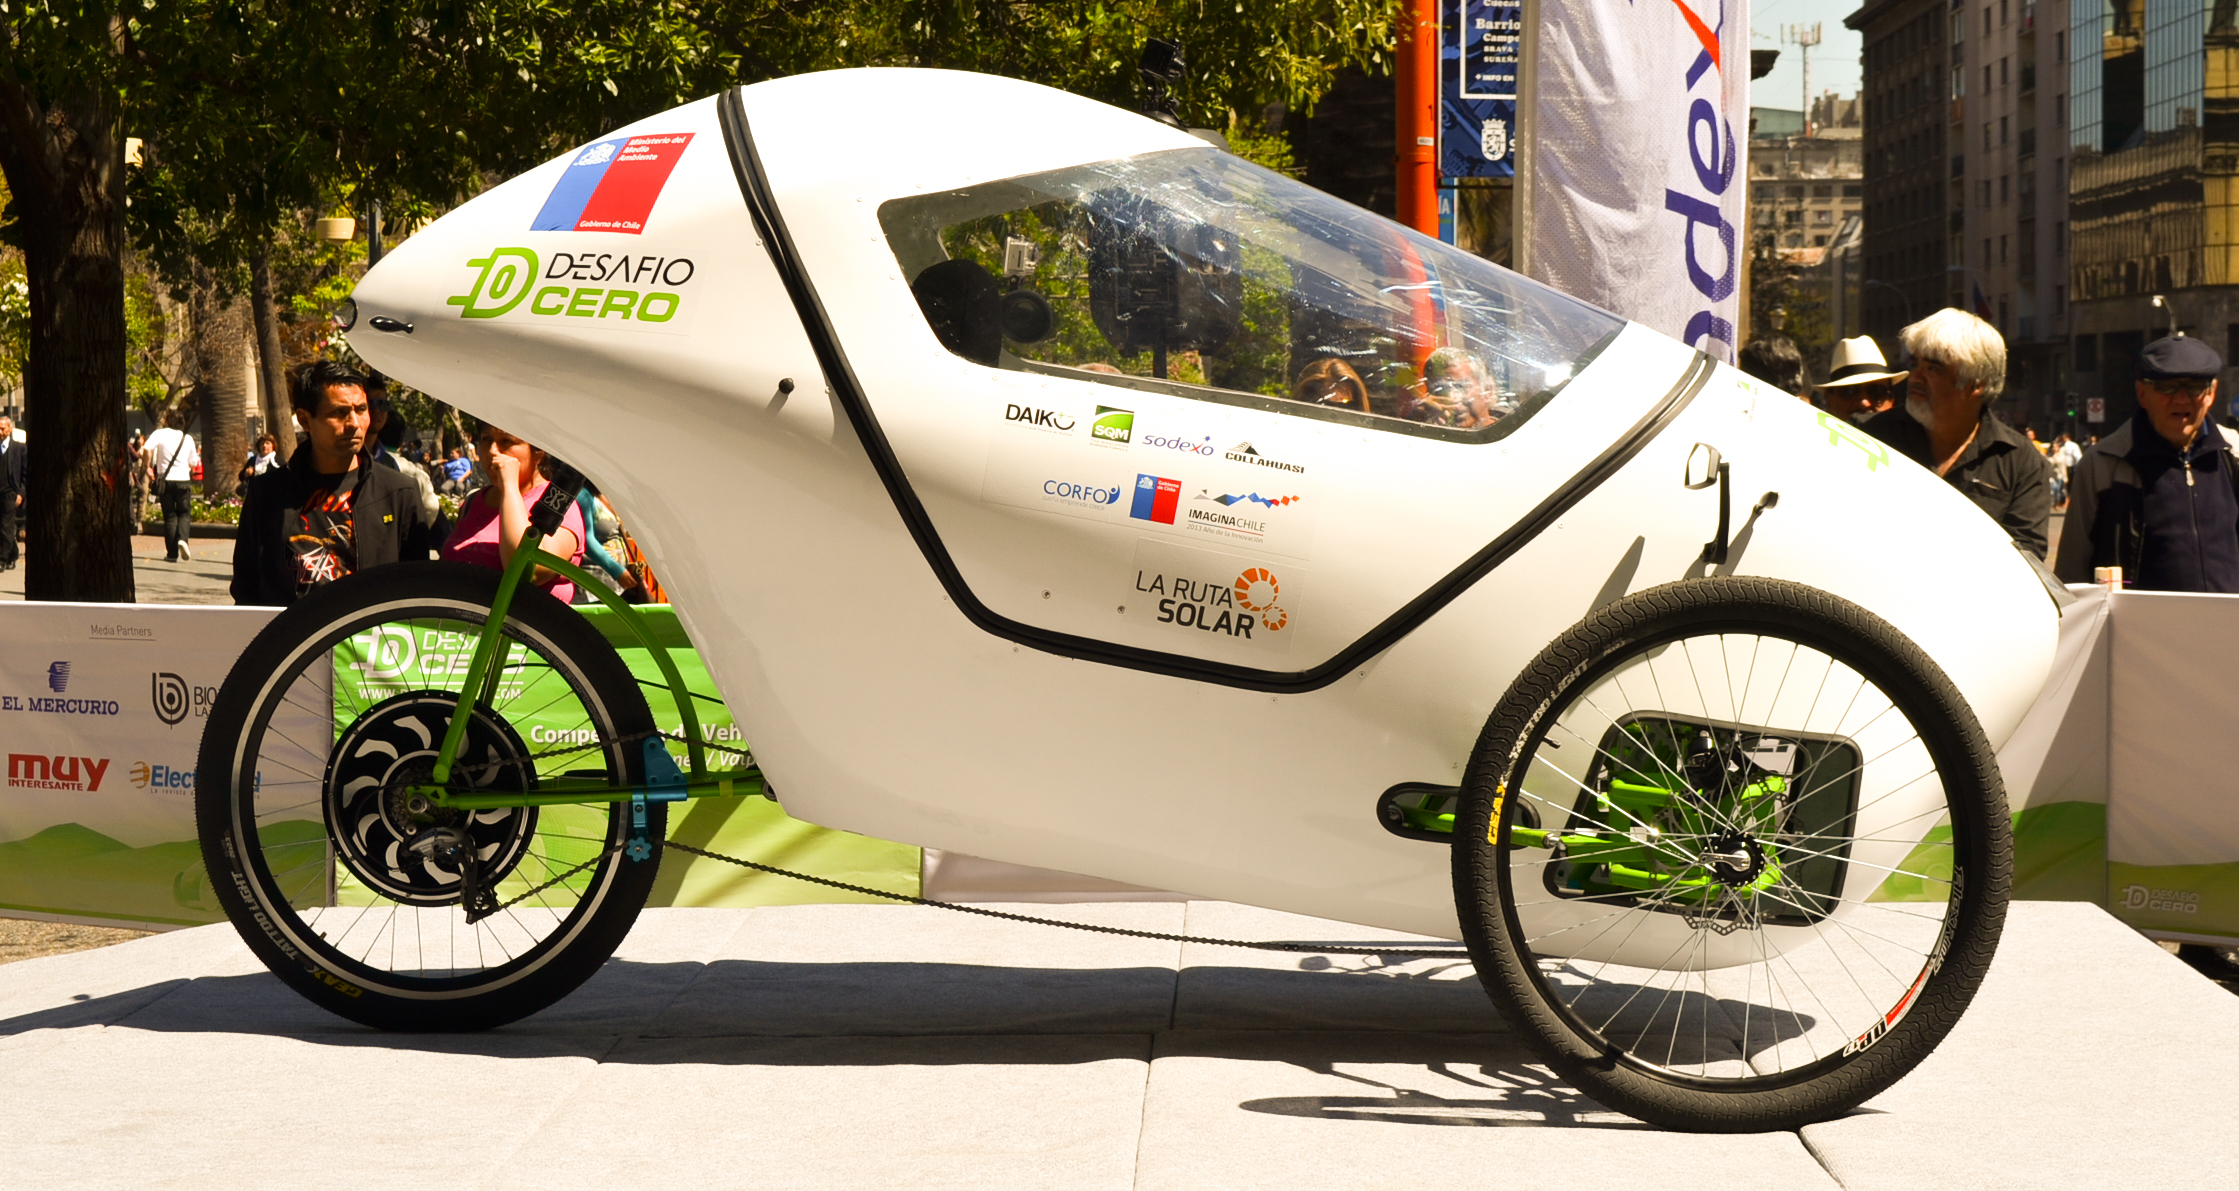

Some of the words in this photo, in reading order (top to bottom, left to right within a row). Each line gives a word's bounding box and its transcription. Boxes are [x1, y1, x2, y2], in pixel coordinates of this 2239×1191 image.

[623, 146, 650, 154] Medio
[628, 136, 670, 146] Ministerio
[672, 136, 686, 144] del
[617, 154, 658, 162] Ambiente
[580, 220, 613, 228] Gobierno
[622, 221, 641, 229] Chile
[545, 253, 695, 286] DESAFIO
[530, 286, 680, 323] CERO
[1094, 425, 1130, 440] SQM
[1142, 434, 1215, 456] sodexo
[1225, 452, 1305, 474] COLLAHUASI
[1043, 480, 1108, 504] CORFO
[1158, 480, 1180, 489] Gobierno
[1187, 523, 1203, 532] 2013
[1203, 525, 1215, 534] Año
[1231, 532, 1264, 544] Innovación
[1136, 570, 1165, 596] LA
[1173, 577, 1233, 609] RUTA
[1157, 598, 1255, 639] SOLAR
[90, 624, 115, 635] Media
[116, 625, 152, 636] Partners
[194, 686, 218, 705] BIO
[2, 696, 24, 711] EL
[28, 697, 119, 715] MERCURIO
[1509, 698, 1550, 759] TATTOO
[1550, 658, 1589, 698] LIGHT
[702, 724, 742, 741] Veh
[8, 754, 111, 792] muy
[8, 779, 84, 791] INTERESANTE
[230, 871, 260, 913] LIGHT
[2150, 889, 2199, 902] DESAFIO
[2149, 900, 2198, 913] CERO
[253, 912, 299, 961] TATTOO
